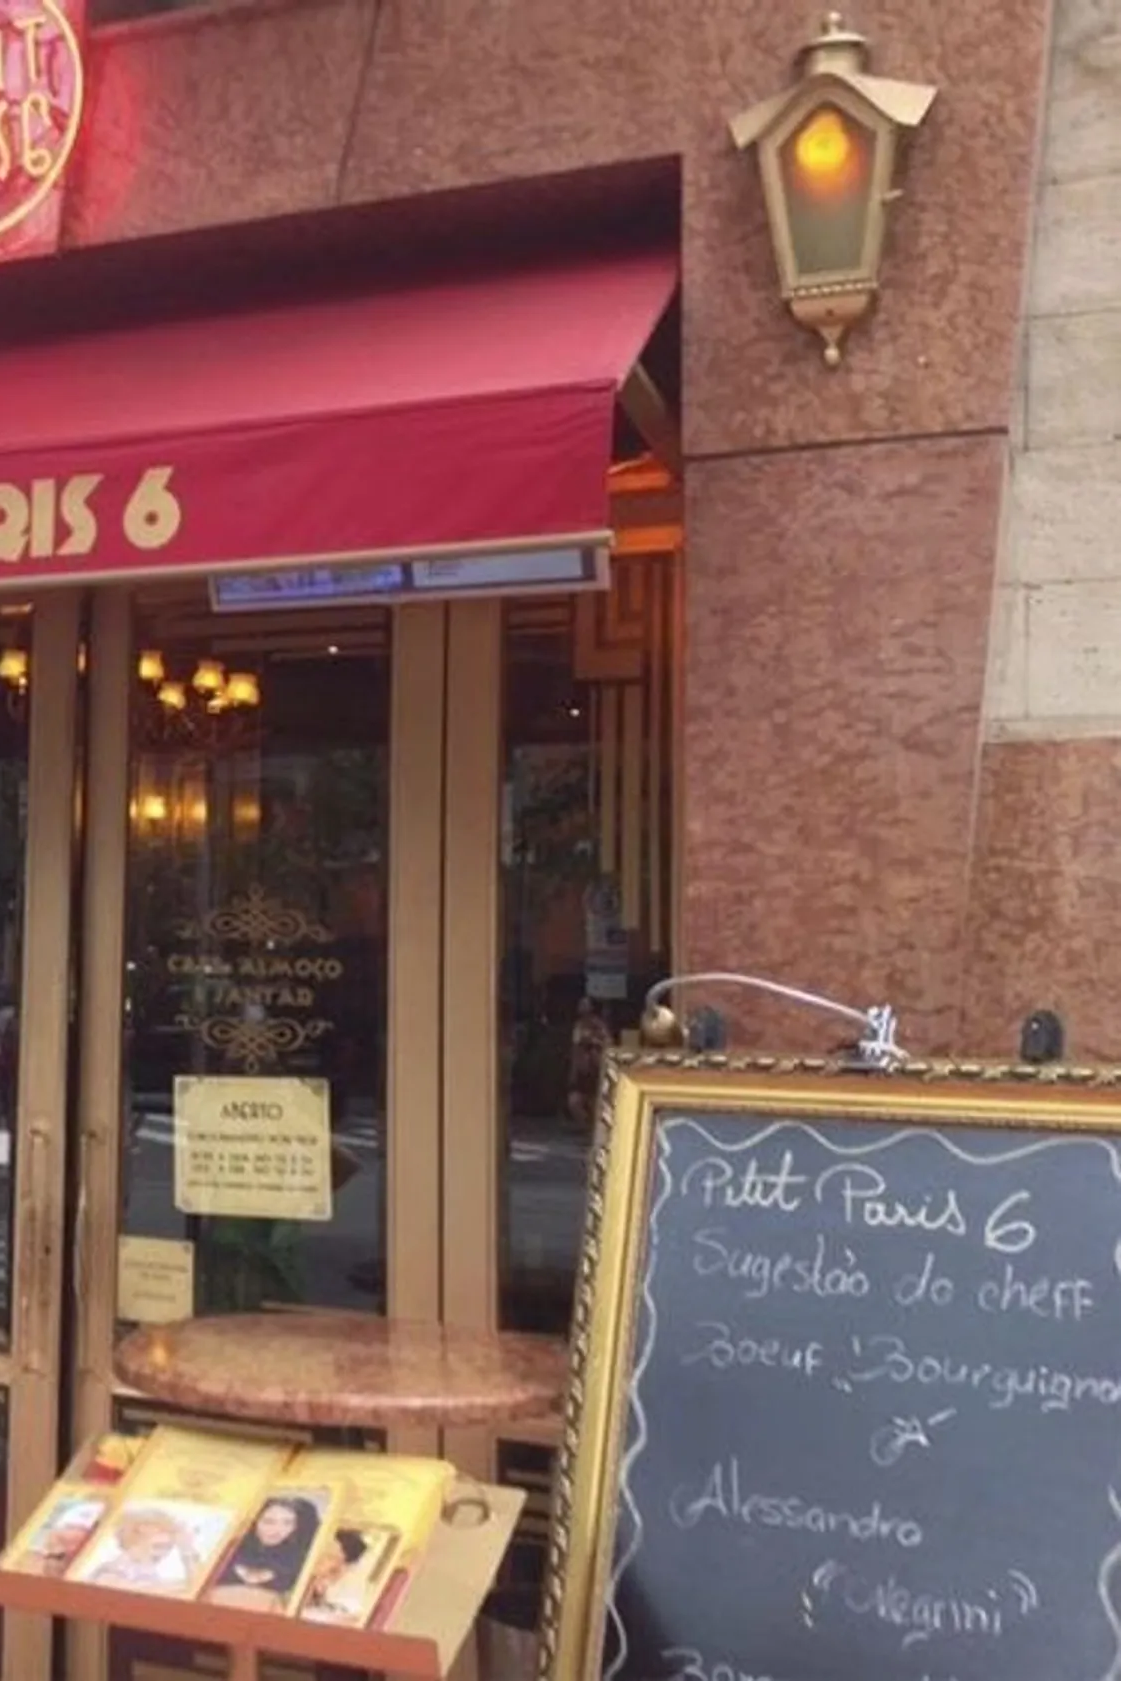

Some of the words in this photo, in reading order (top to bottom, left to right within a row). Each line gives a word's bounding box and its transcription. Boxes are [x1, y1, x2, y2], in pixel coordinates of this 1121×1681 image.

[121, 466, 182, 550] 6
[815, 1162, 966, 1237] Paris
[983, 1190, 1036, 1253] 6
[892, 1251, 955, 1307] do
[671, 1454, 924, 1548] Alessandro
